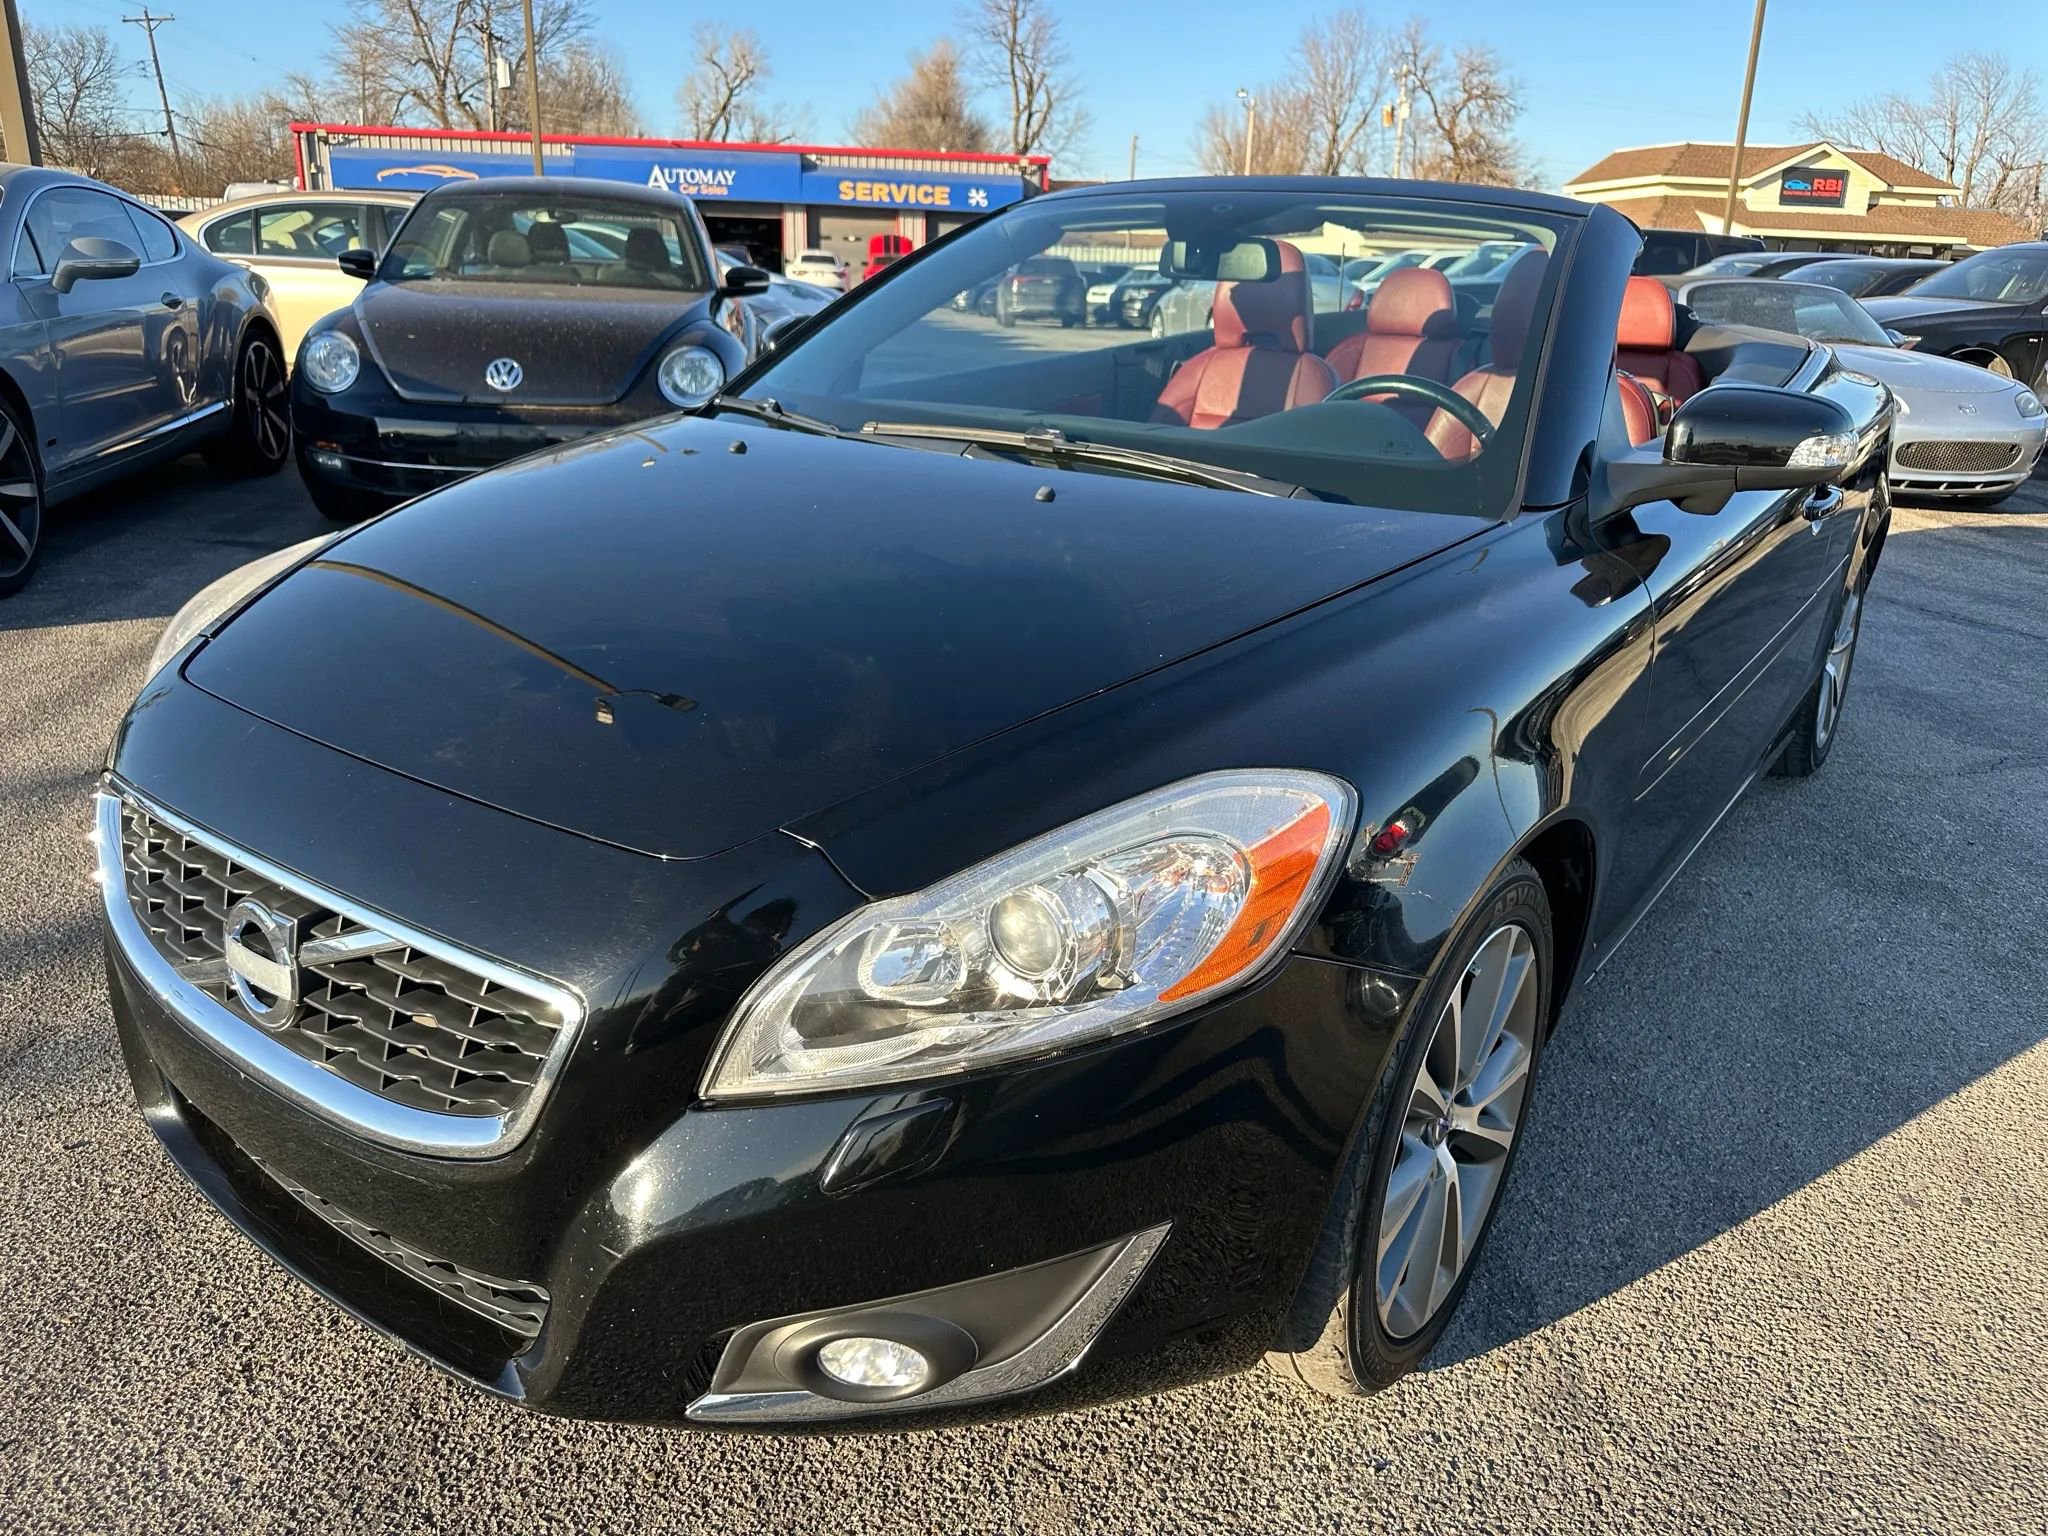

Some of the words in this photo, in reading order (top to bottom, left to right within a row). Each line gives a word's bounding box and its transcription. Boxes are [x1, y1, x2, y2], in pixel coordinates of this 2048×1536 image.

[648, 164, 736, 191] AUTOMAY
[1813, 178, 1842, 191] RBI
[679, 183, 698, 194] Car
[699, 184, 728, 195] Sales
[839, 180, 951, 205] SERVICE
